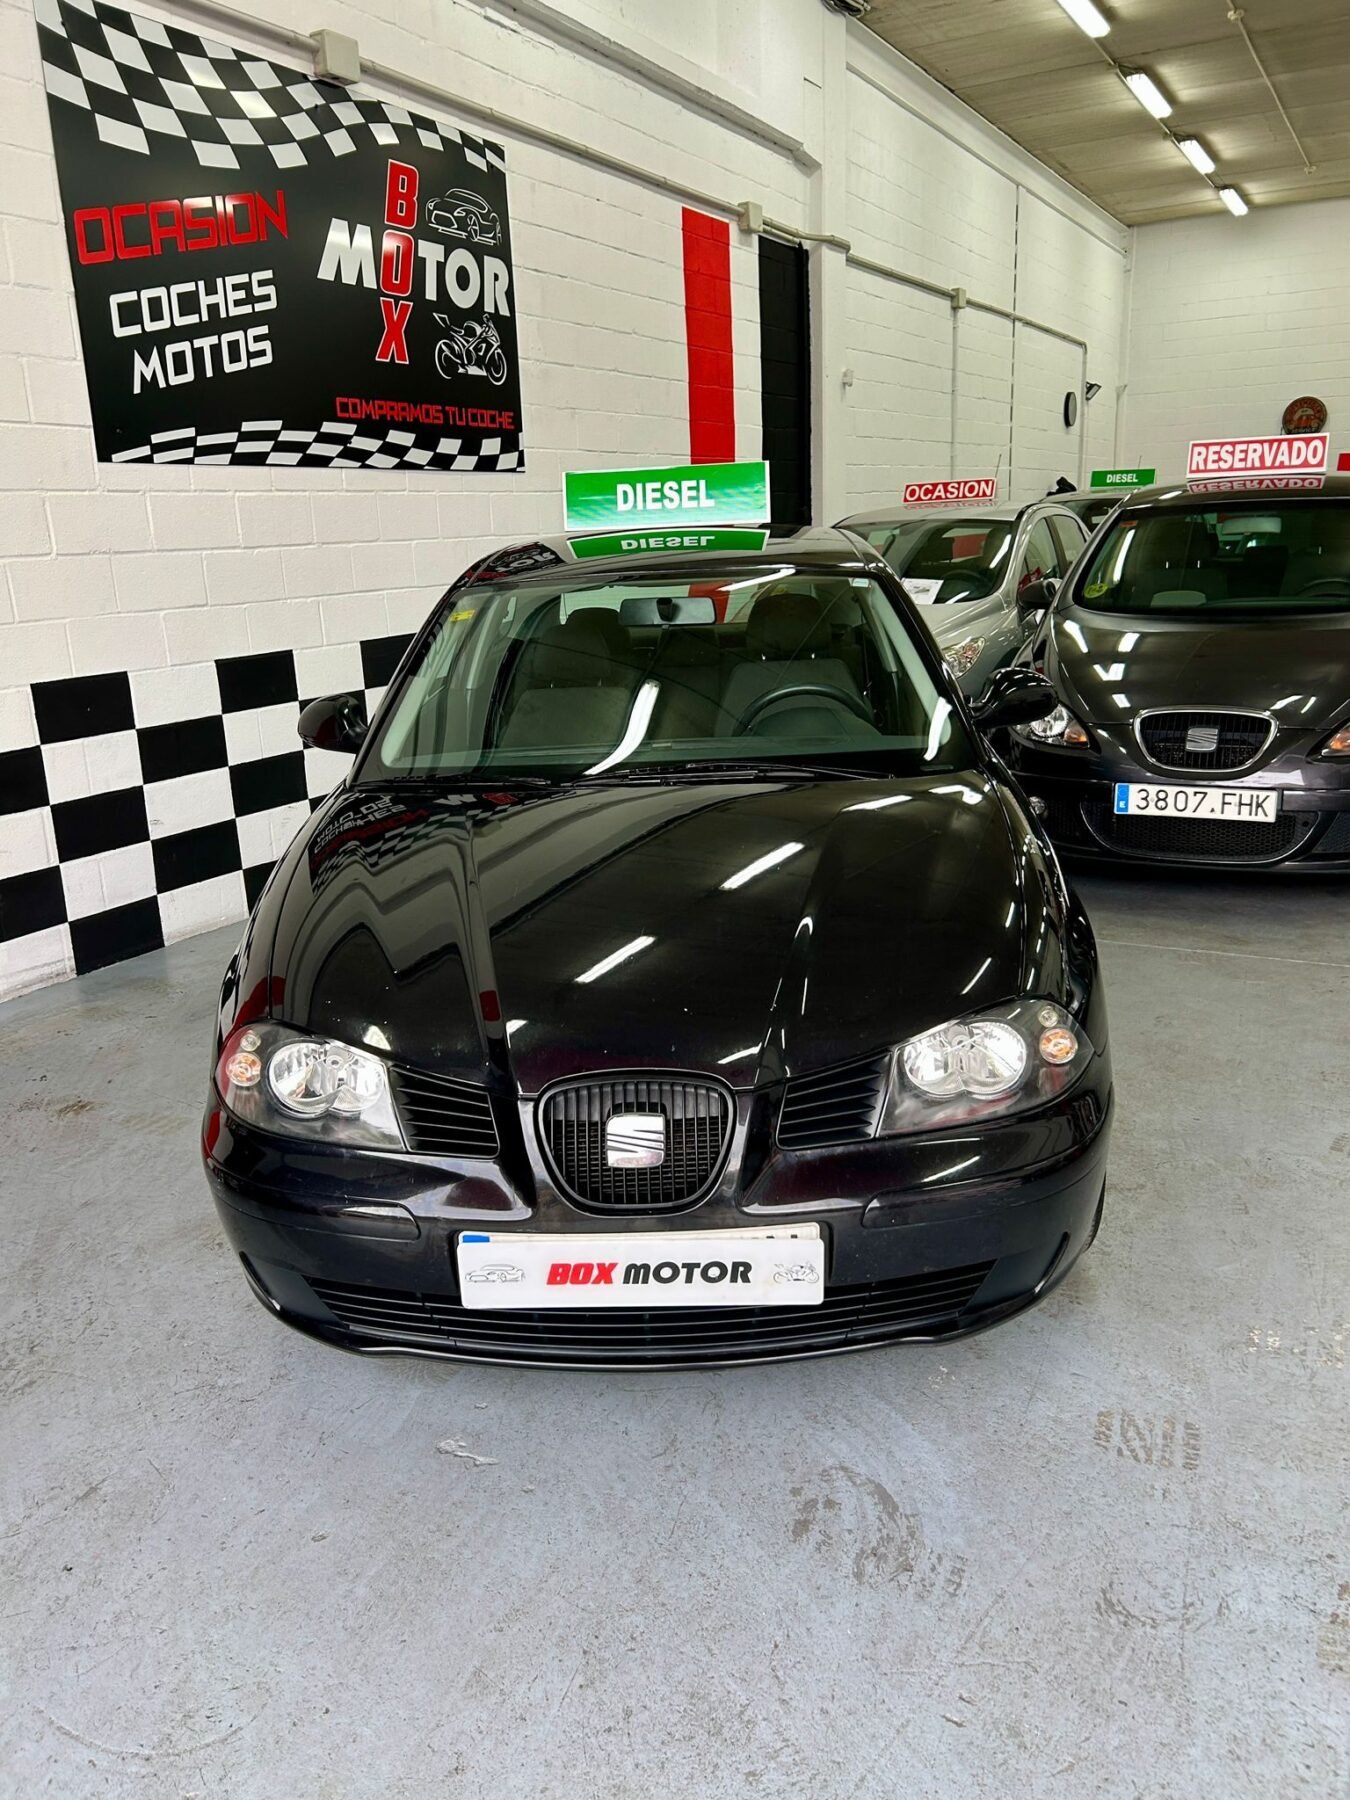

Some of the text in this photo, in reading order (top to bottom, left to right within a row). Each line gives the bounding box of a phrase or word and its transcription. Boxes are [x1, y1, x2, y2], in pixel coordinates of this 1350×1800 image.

[73, 190, 288, 265] OCASION
[317, 217, 511, 317] MOTOR
[375, 159, 420, 364] BOX
[109, 269, 278, 338] COCHES
[133, 325, 273, 394] MOTOS
[335, 397, 515, 429] COMPRAMOS TU COCHE
[1191, 439, 1324, 471] RESERVADO
[905, 480, 993, 501] OCASION
[1106, 473, 1139, 483] DIESEL
[616, 479, 715, 512] DIESEL
[546, 1261, 753, 1286] BOX MOTOR
